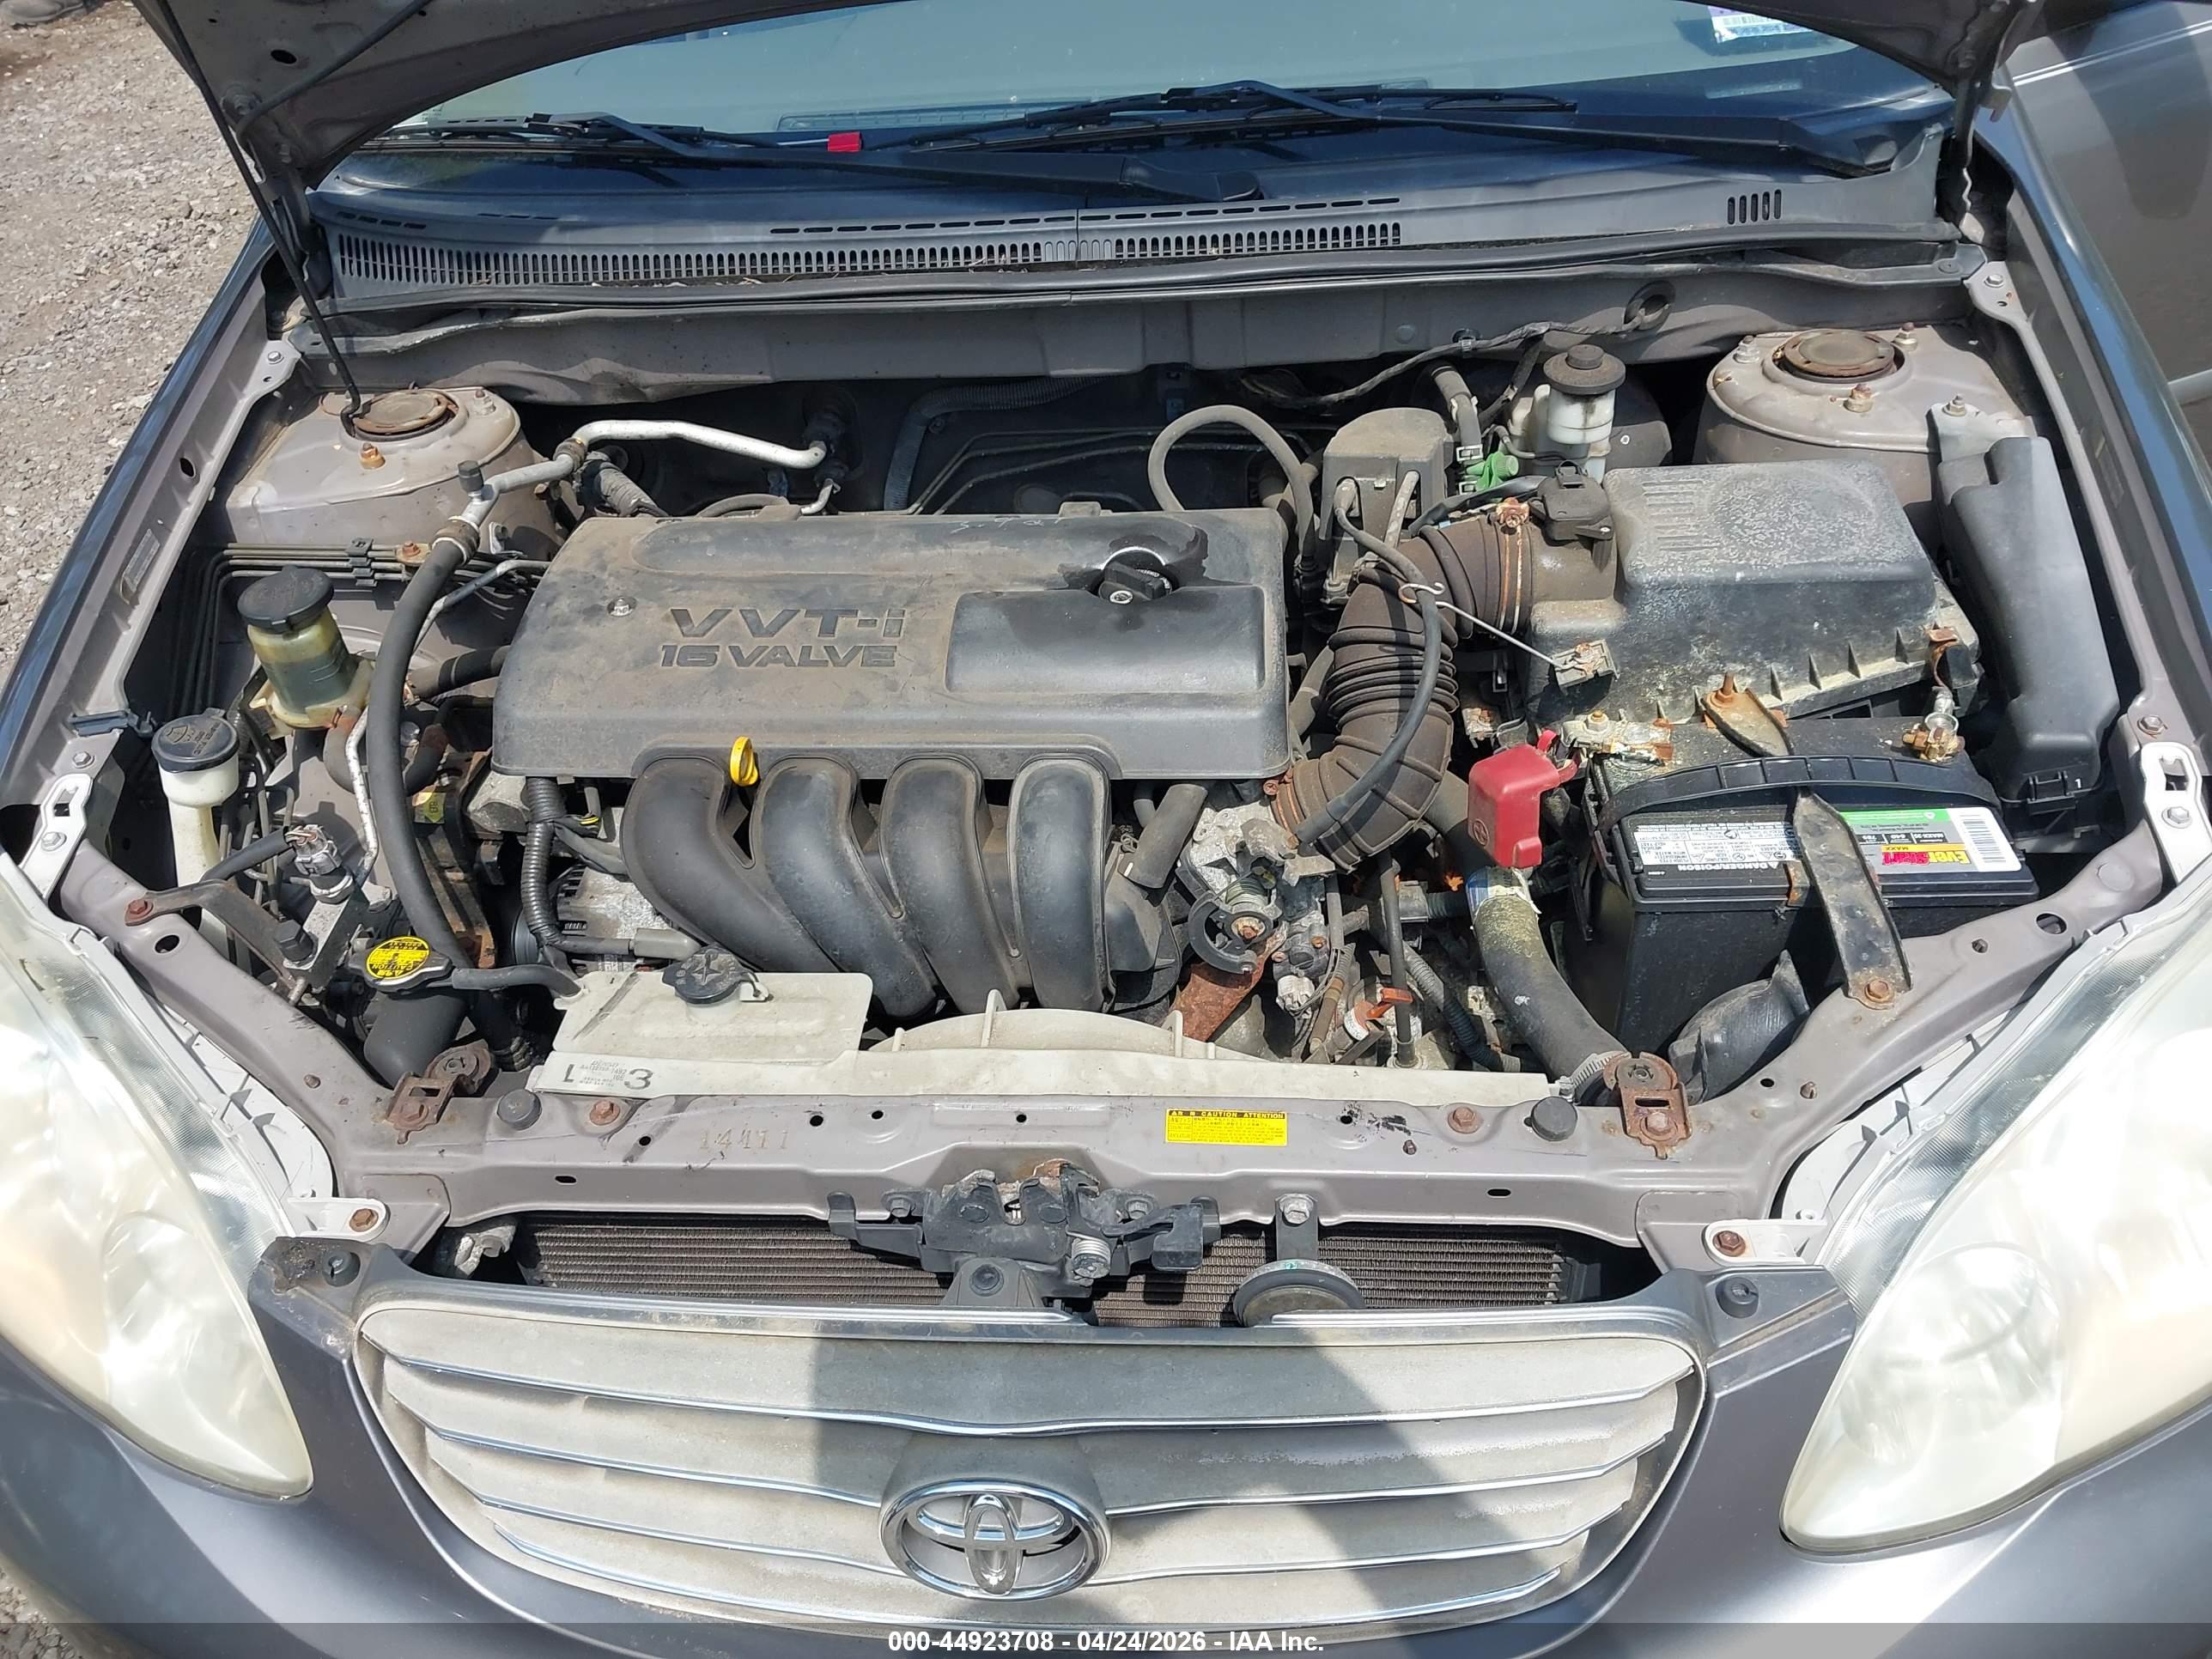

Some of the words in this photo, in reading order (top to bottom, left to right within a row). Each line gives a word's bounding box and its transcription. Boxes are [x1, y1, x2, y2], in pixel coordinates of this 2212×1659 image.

[670, 608, 905, 638] VVT-i
[660, 645, 720, 667] 16
[727, 645, 897, 667] VALVE
[1677, 861, 1769, 872] DANGER/POISON
[1881, 850, 1972, 865] EverStart
[372, 963, 412, 971] CAUTION
[563, 1064, 575, 1084] L
[623, 1067, 654, 1091] 3
